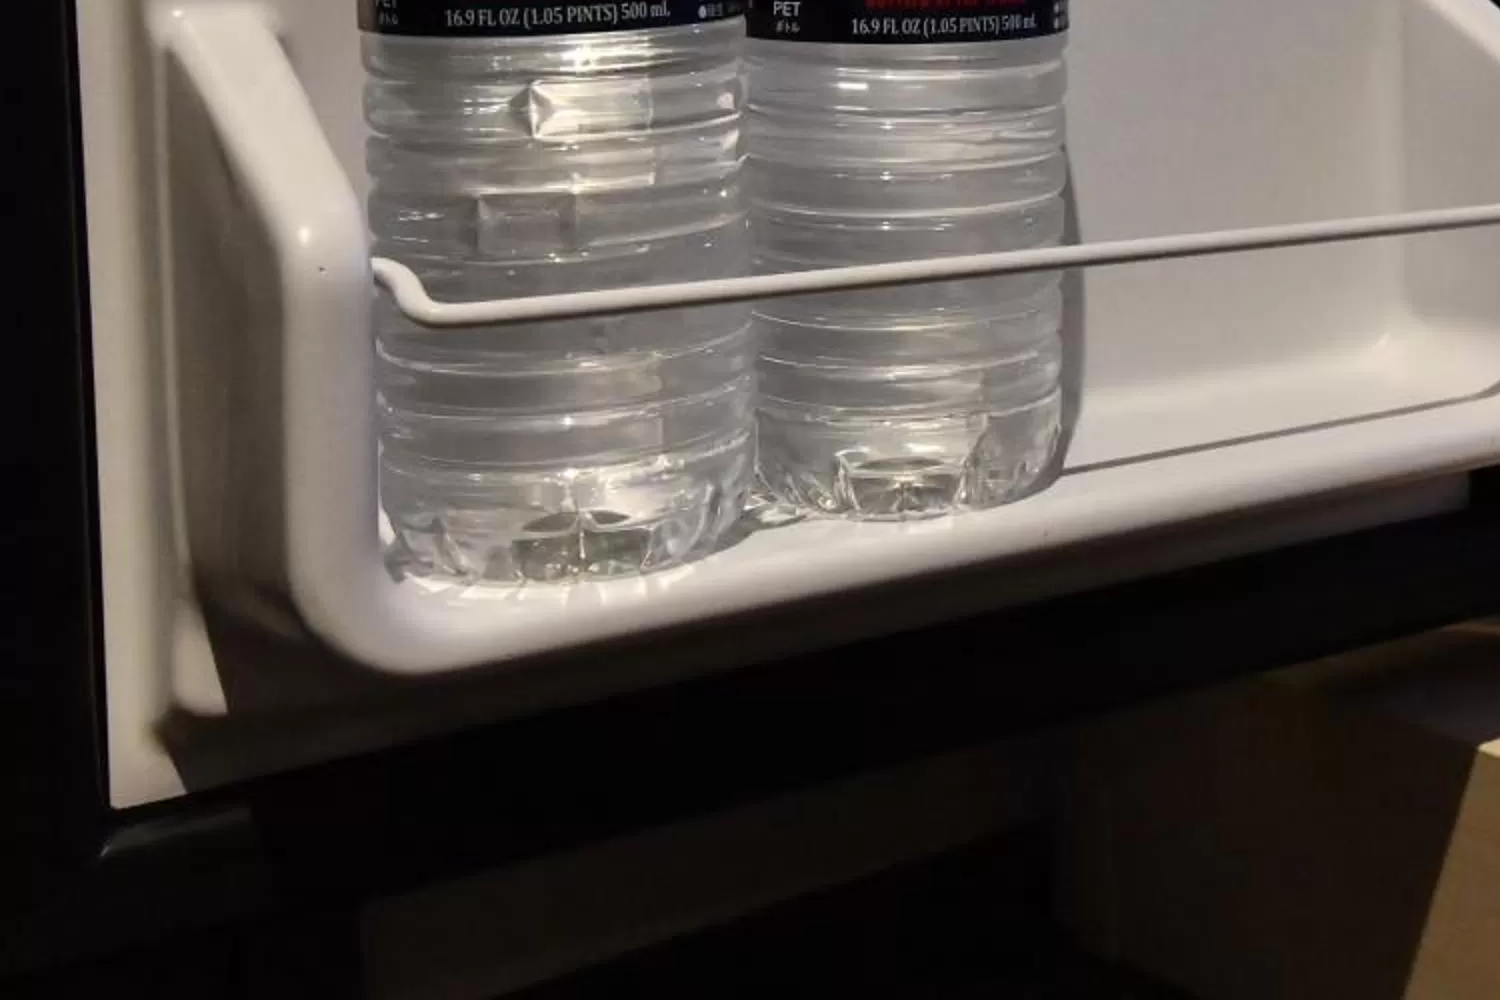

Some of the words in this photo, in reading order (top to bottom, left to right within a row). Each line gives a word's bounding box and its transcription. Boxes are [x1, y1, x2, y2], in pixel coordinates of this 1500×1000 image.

[478, 8, 496, 27] FL
[500, 7, 520, 26] OZ
[567, 2, 618, 25] PINTS)
[621, 1, 648, 20] 500
[773, 0, 801, 17] PET
[851, 17, 881, 35] 16.9
[883, 17, 899, 35] FL
[901, 17, 921, 35] OZ
[923, 16, 957, 38] (1.05
